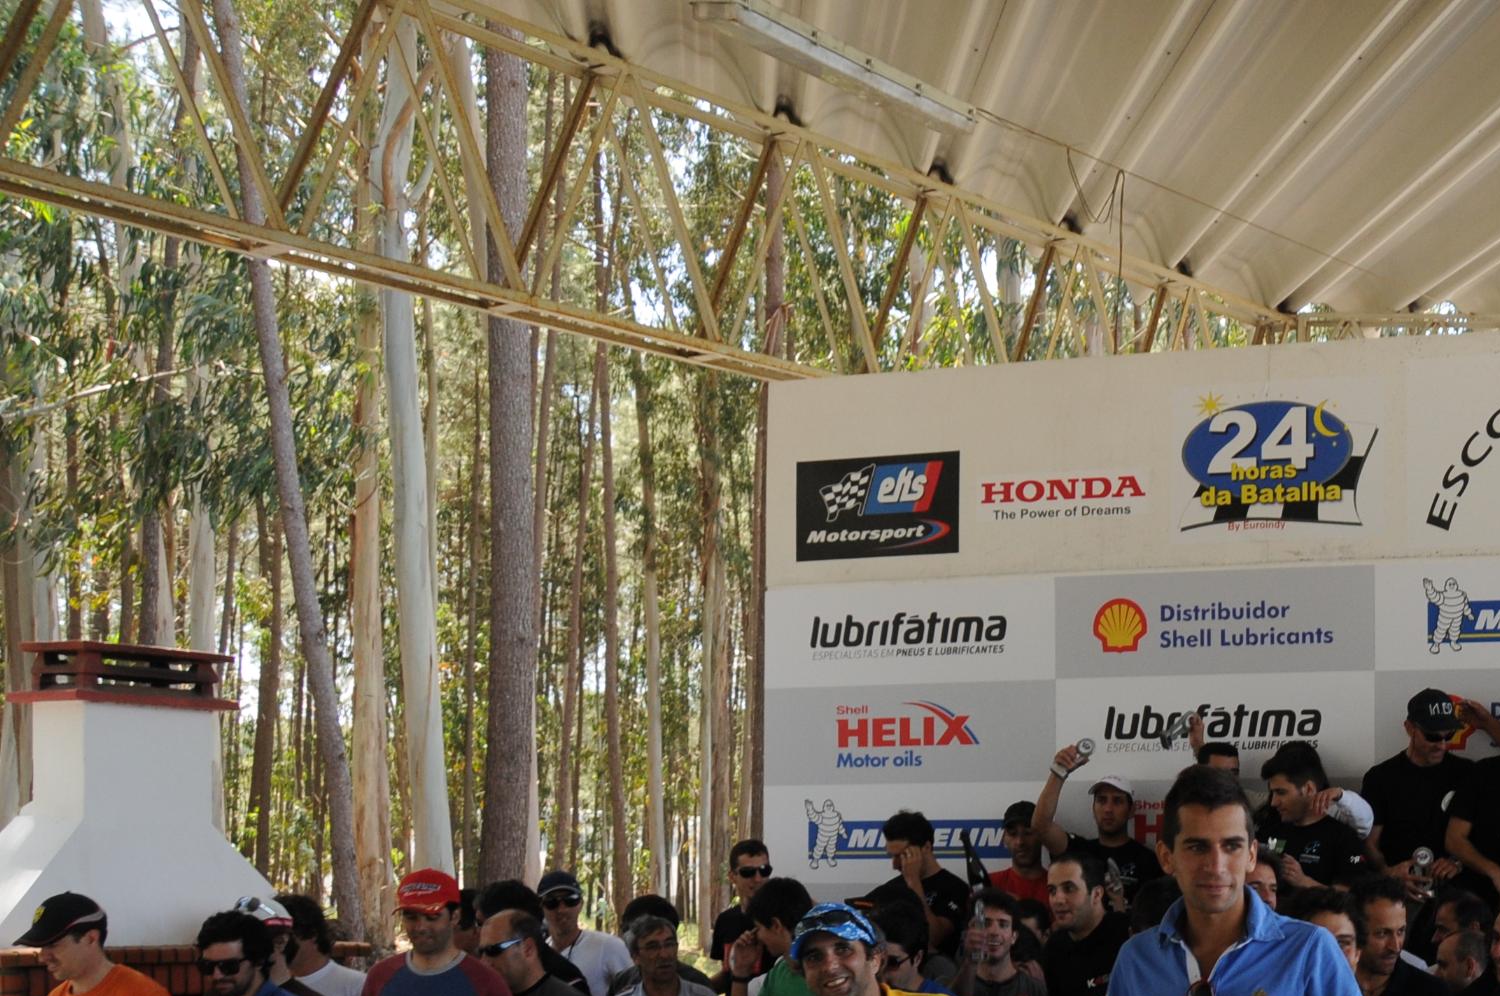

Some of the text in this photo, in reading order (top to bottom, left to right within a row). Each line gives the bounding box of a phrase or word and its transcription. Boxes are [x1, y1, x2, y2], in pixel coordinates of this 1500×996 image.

[1207, 406, 1315, 475] 24
[1231, 463, 1297, 481] horas
[980, 476, 1146, 504] HONDA
[1201, 481, 1342, 507] da Batalha
[993, 504, 1131, 520] The Power of Dreams
[807, 524, 925, 544] Motorsport
[1228, 522, 1240, 532] By
[1160, 600, 1290, 622] Distribuidor
[1160, 627, 1334, 648] Shell Lubricants
[812, 649, 879, 661] ESPECIALISTAS
[896, 647, 925, 658] PNEUS
[927, 647, 933, 656] E
[935, 645, 1005, 656] LUBRIFICANTES
[836, 705, 868, 716] Shell
[836, 715, 977, 748] HELIX
[1104, 704, 1322, 740] lubrfátima
[836, 751, 922, 769] Motor oils
[848, 827, 1004, 848] MIELIN
